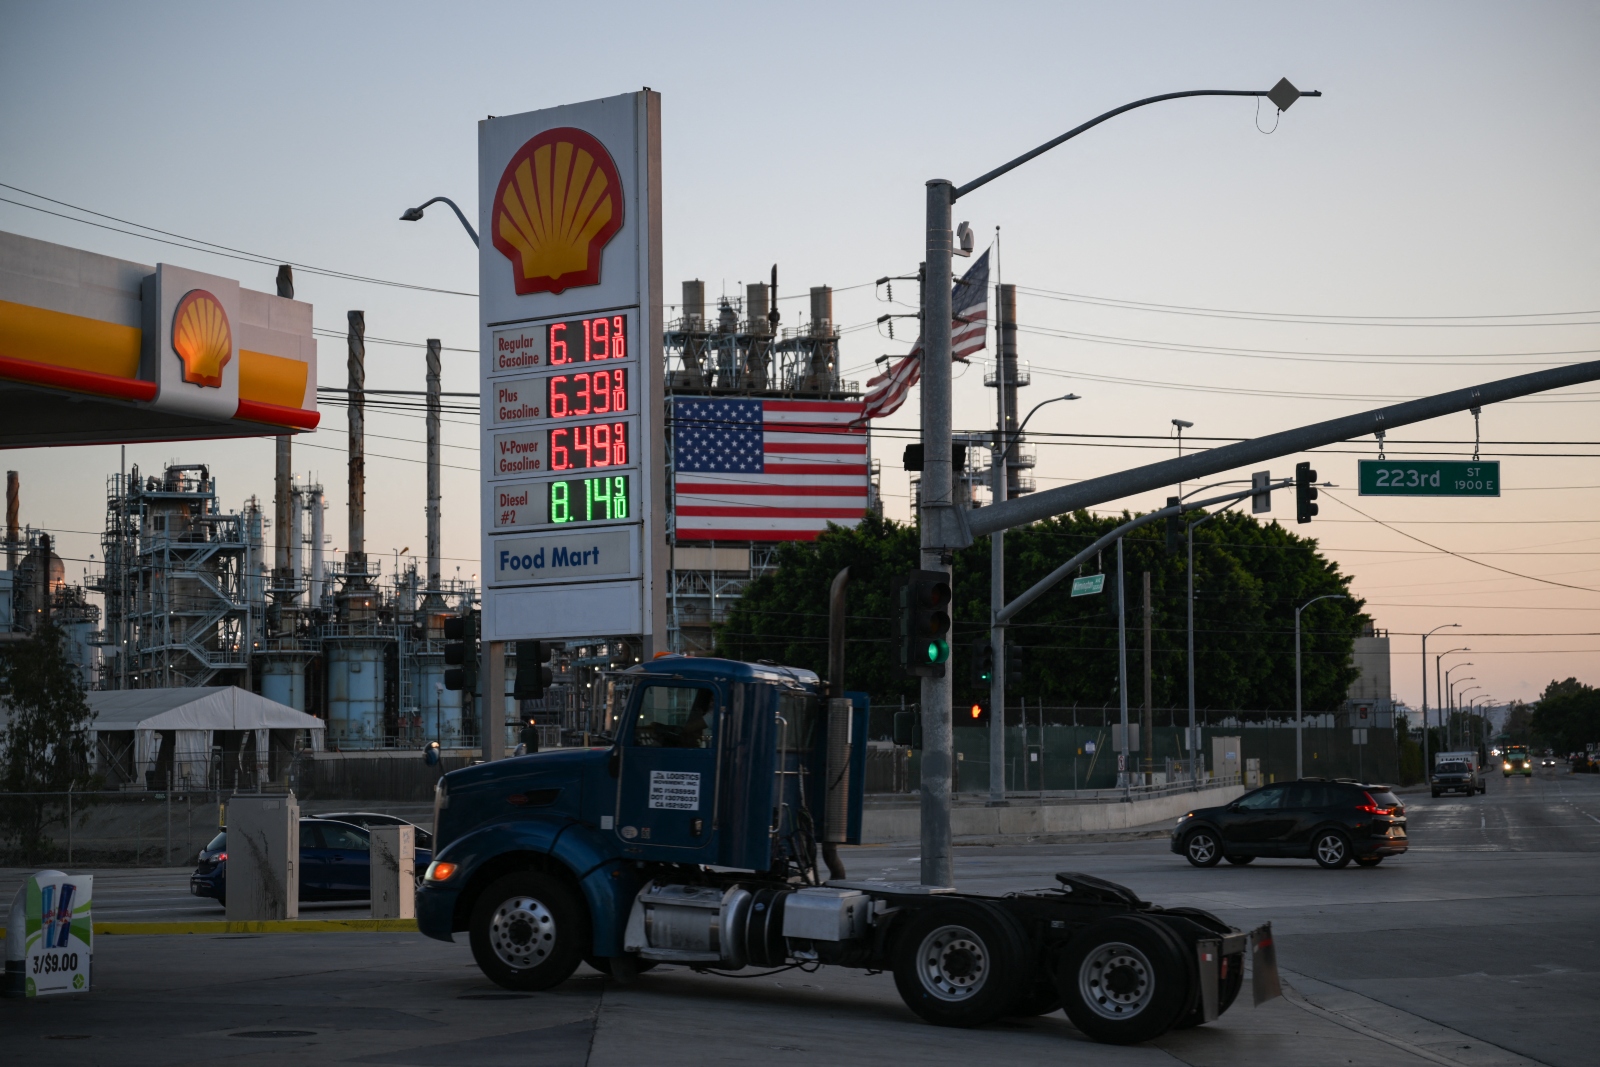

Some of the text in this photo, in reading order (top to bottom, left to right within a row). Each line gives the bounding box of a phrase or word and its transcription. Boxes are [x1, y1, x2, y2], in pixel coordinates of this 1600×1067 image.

[498, 335, 534, 355] Regular
[550, 318, 609, 365] 6.19
[499, 354, 539, 368] Gasoline
[499, 389, 518, 403] Plus
[550, 371, 610, 418] 6.39
[499, 406, 540, 421] Gasoline
[500, 440, 538, 456] V-Power
[551, 424, 610, 470] 6.49
[500, 458, 540, 473] Gasoline
[1467, 468, 1481, 477] ST
[1376, 469, 1440, 487] 223rd
[1455, 480, 1493, 490] 1900 E
[500, 491, 528, 507] Diesel
[551, 477, 611, 523] 8.14
[500, 510, 516, 524] #2
[500, 546, 599, 571] Food Mart
[33, 952, 78, 974] 3/$9.00
